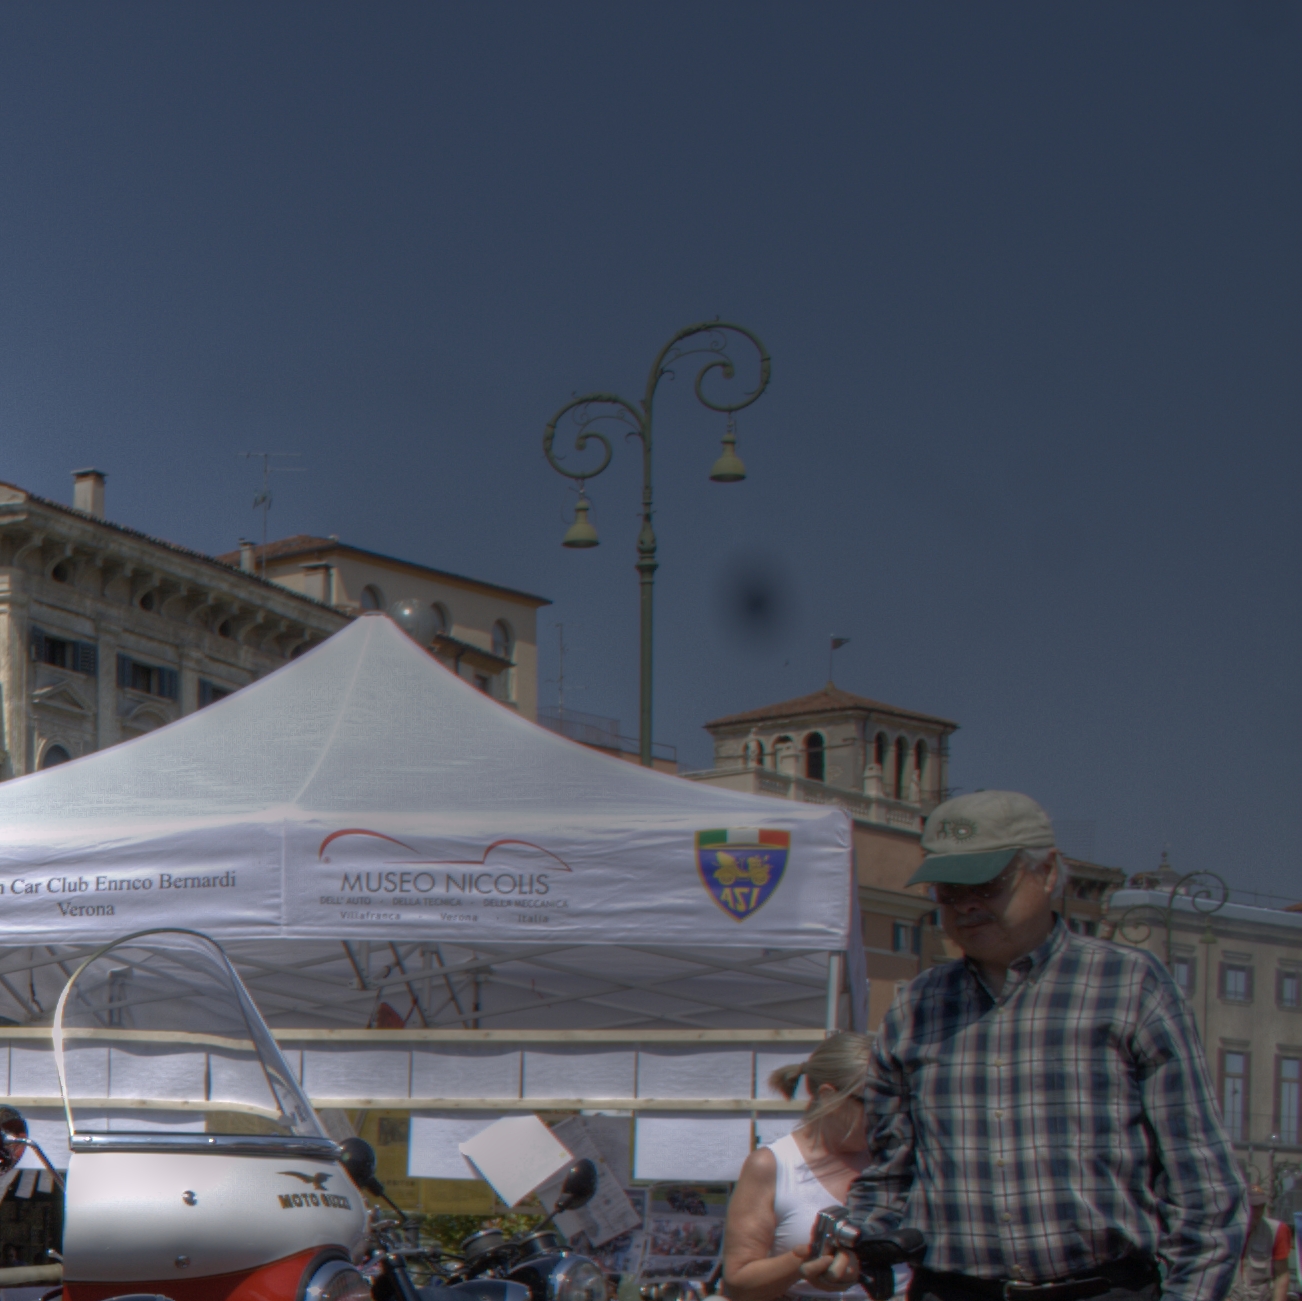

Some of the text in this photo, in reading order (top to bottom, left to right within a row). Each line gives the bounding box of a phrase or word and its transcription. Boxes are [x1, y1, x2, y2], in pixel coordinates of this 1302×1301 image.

[10, 878, 42, 895] Car
[46, 875, 89, 894] Club
[94, 875, 153, 892] Enrico
[158, 870, 236, 890] Bernardi
[340, 871, 550, 895] MUSEO NICOLIS
[345, 896, 372, 906] AUTO
[392, 897, 422, 907] DELLA
[422, 897, 463, 907] TECNICA
[483, 898, 512, 908] DELLA
[513, 898, 569, 909] MECCANICA
[720, 887, 761, 913] ASI
[56, 902, 116, 917] Verona
[339, 911, 550, 924] Villafranca Verona Italia
[277, 1193, 321, 1210] MOTO
